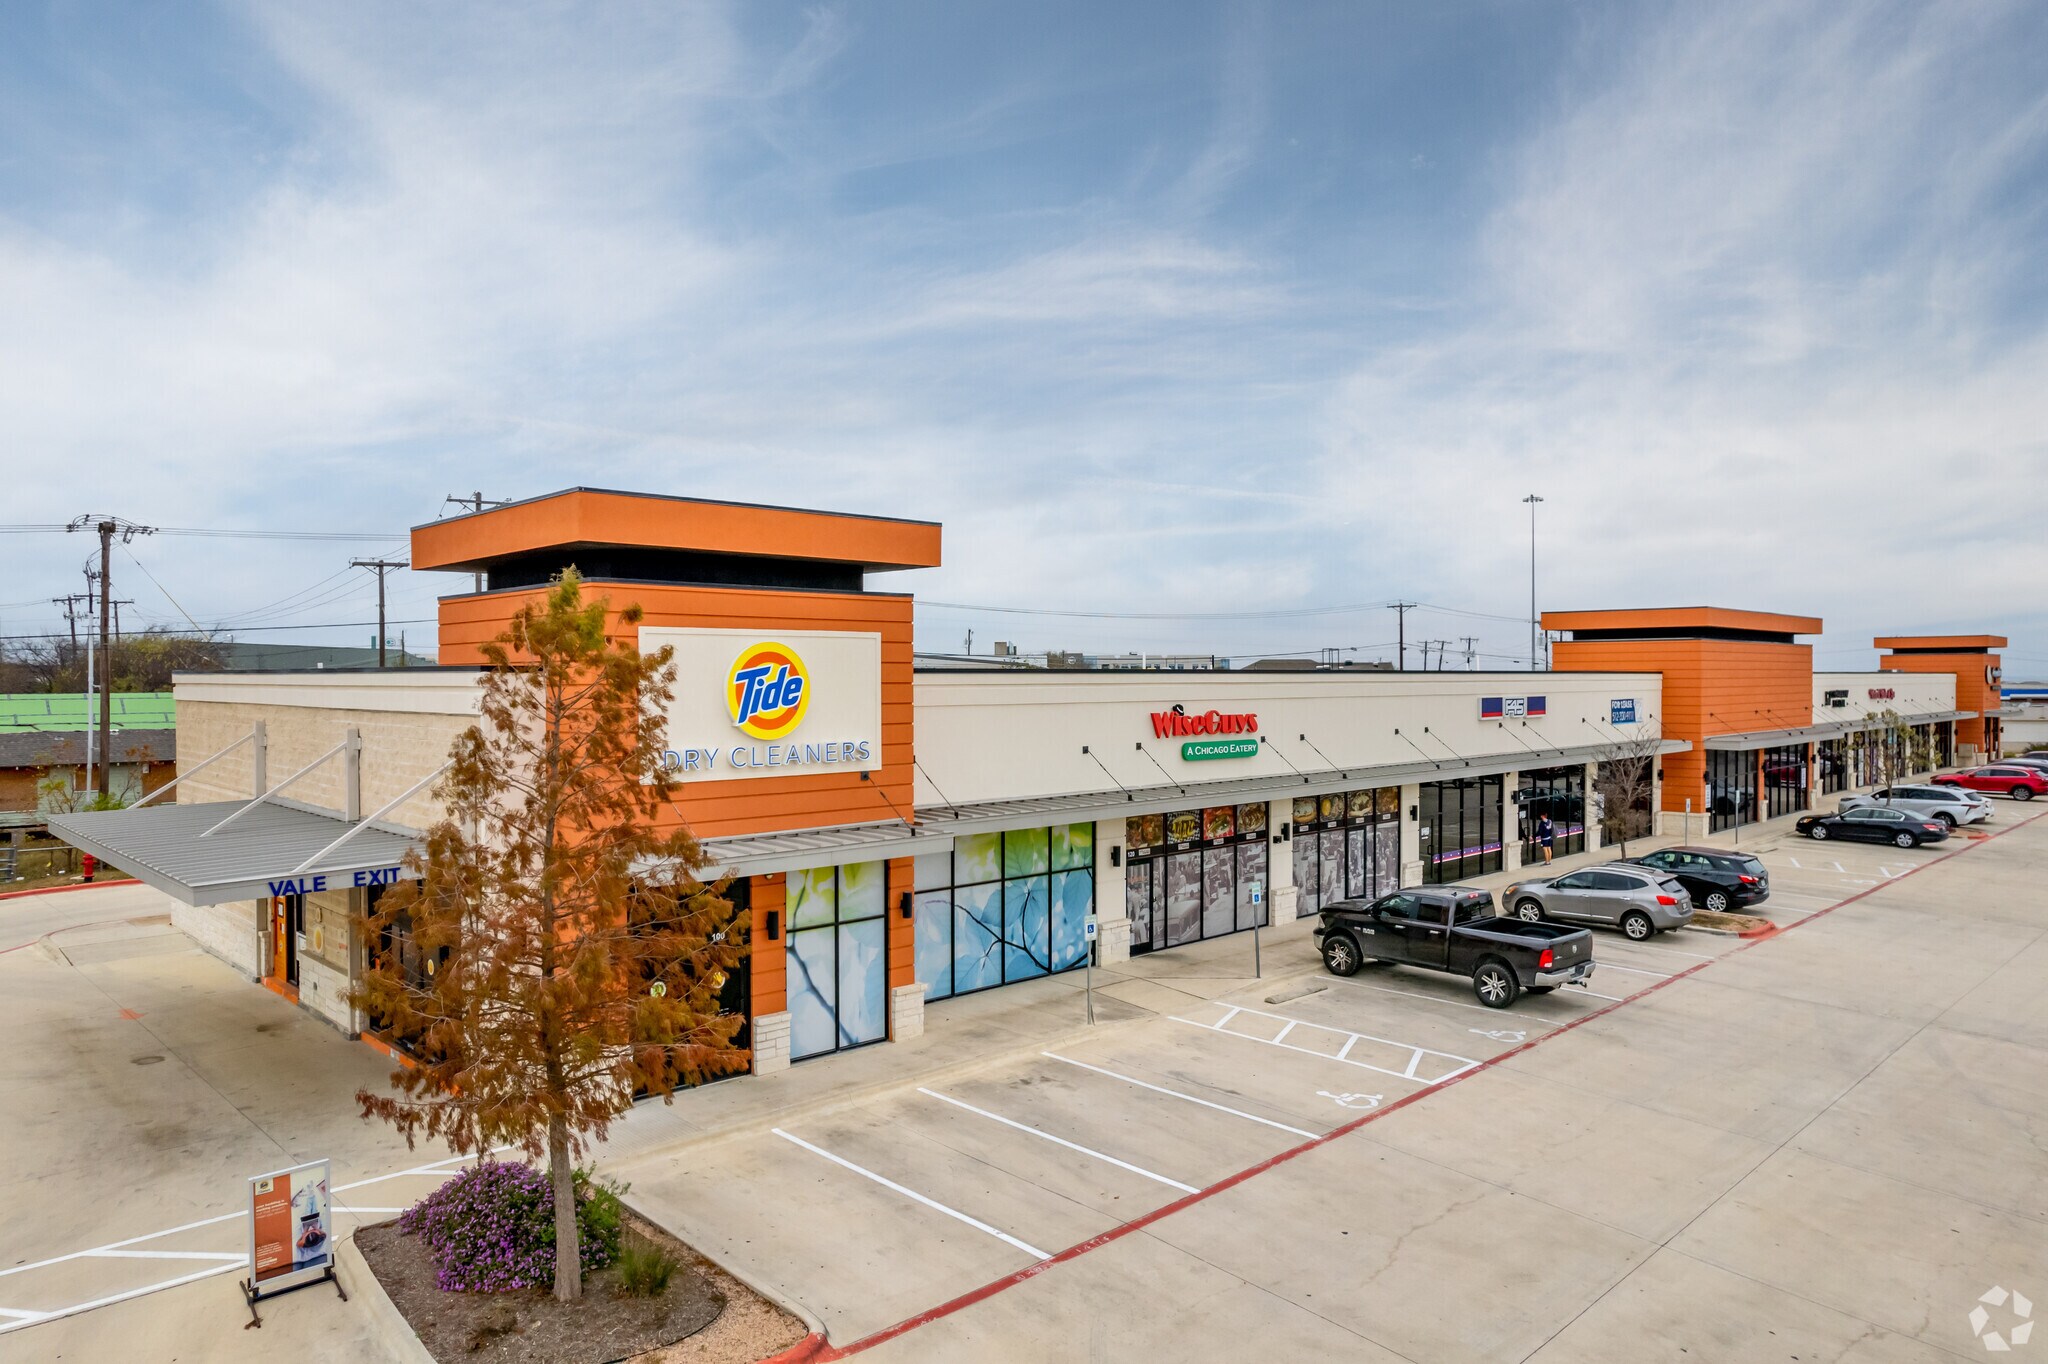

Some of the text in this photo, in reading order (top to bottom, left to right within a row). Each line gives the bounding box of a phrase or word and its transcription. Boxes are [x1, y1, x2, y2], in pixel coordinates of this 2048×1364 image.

[733, 664, 804, 725] Tide
[1612, 700, 1632, 709] FOR LEASE
[1150, 709, 1260, 739] WiseGuys
[663, 740, 871, 771] DRY CLEANERS
[1186, 747, 1195, 756] A
[268, 867, 401, 897] VALE EXIT
[711, 932, 726, 942] 100
